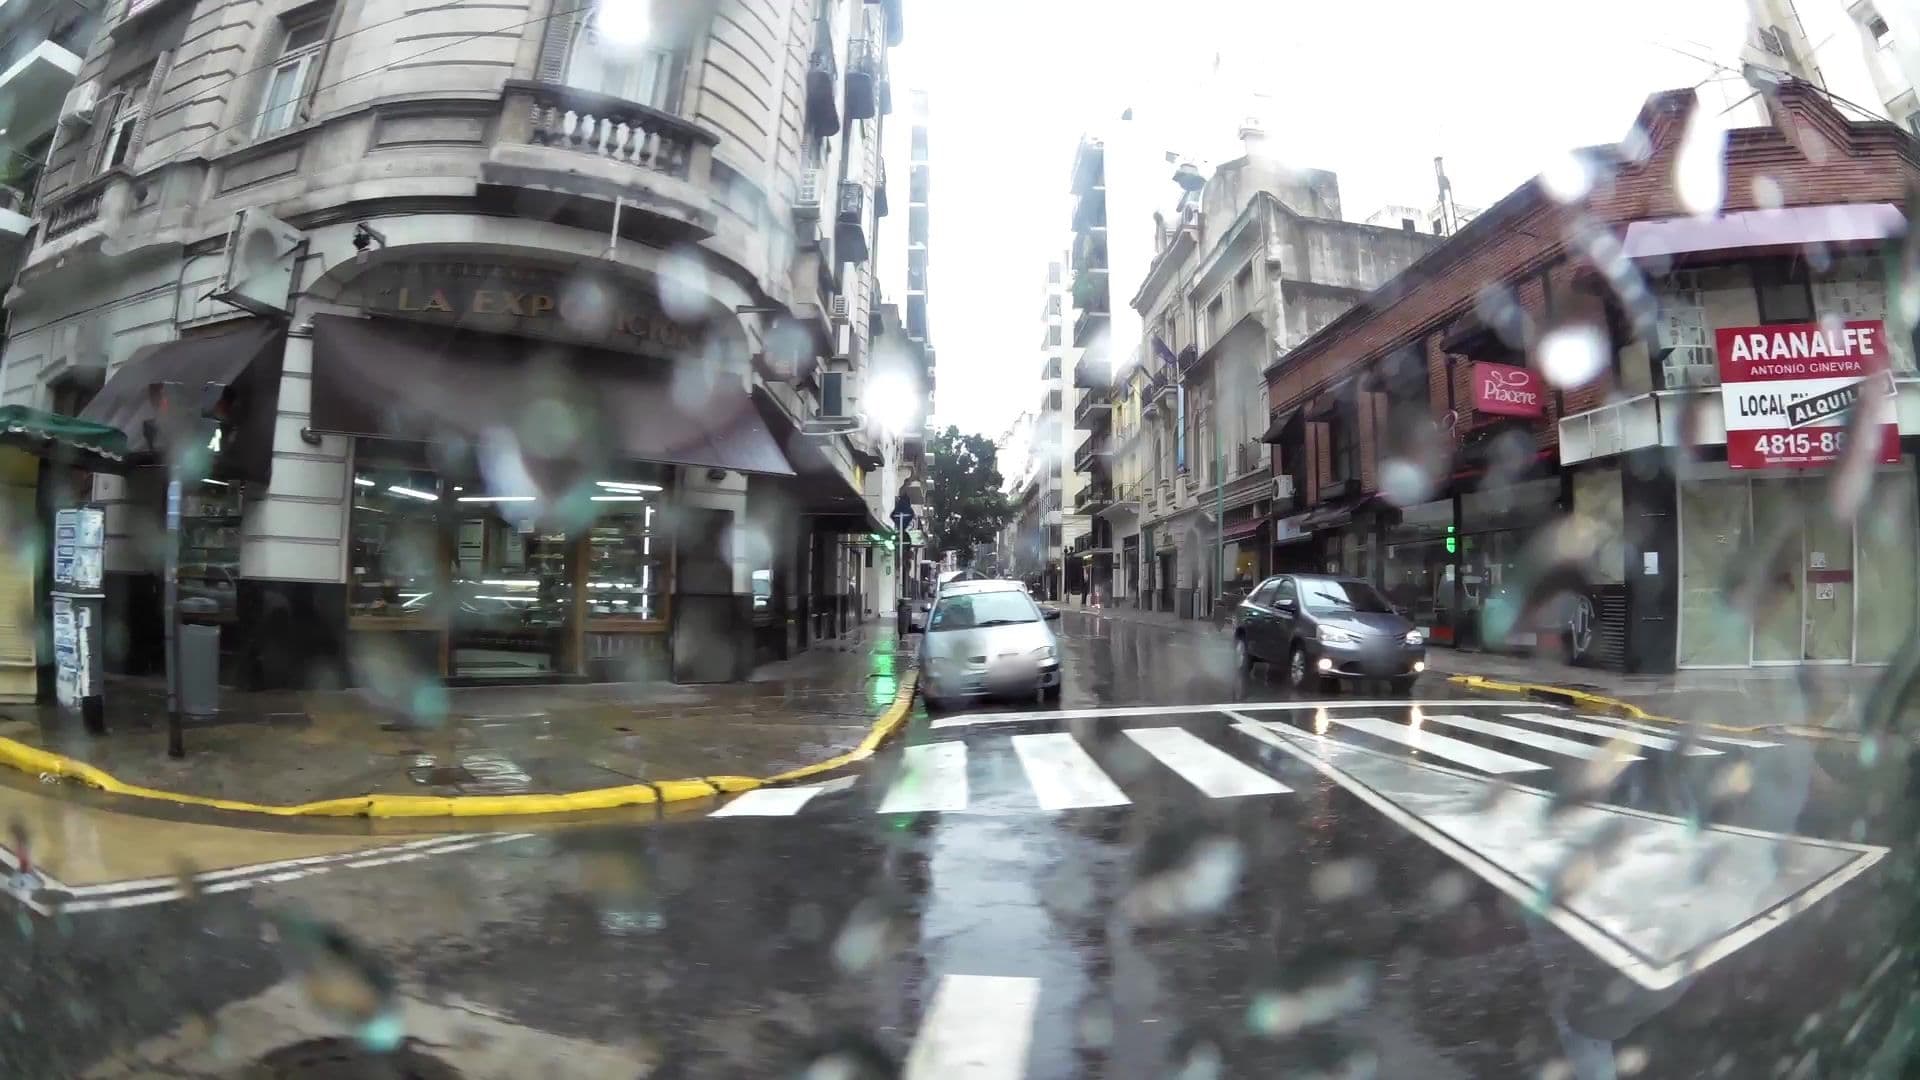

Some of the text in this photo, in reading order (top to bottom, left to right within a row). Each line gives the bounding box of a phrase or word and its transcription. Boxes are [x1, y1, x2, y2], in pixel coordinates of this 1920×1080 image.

[1731, 328, 1874, 361] ARANALFE
[1750, 361, 1861, 376] ANTONIO GINEVRA
[1483, 379, 1537, 405] Piacere
[1739, 394, 1785, 416] LOCAL
[1794, 384, 1880, 422] ALQUIL
